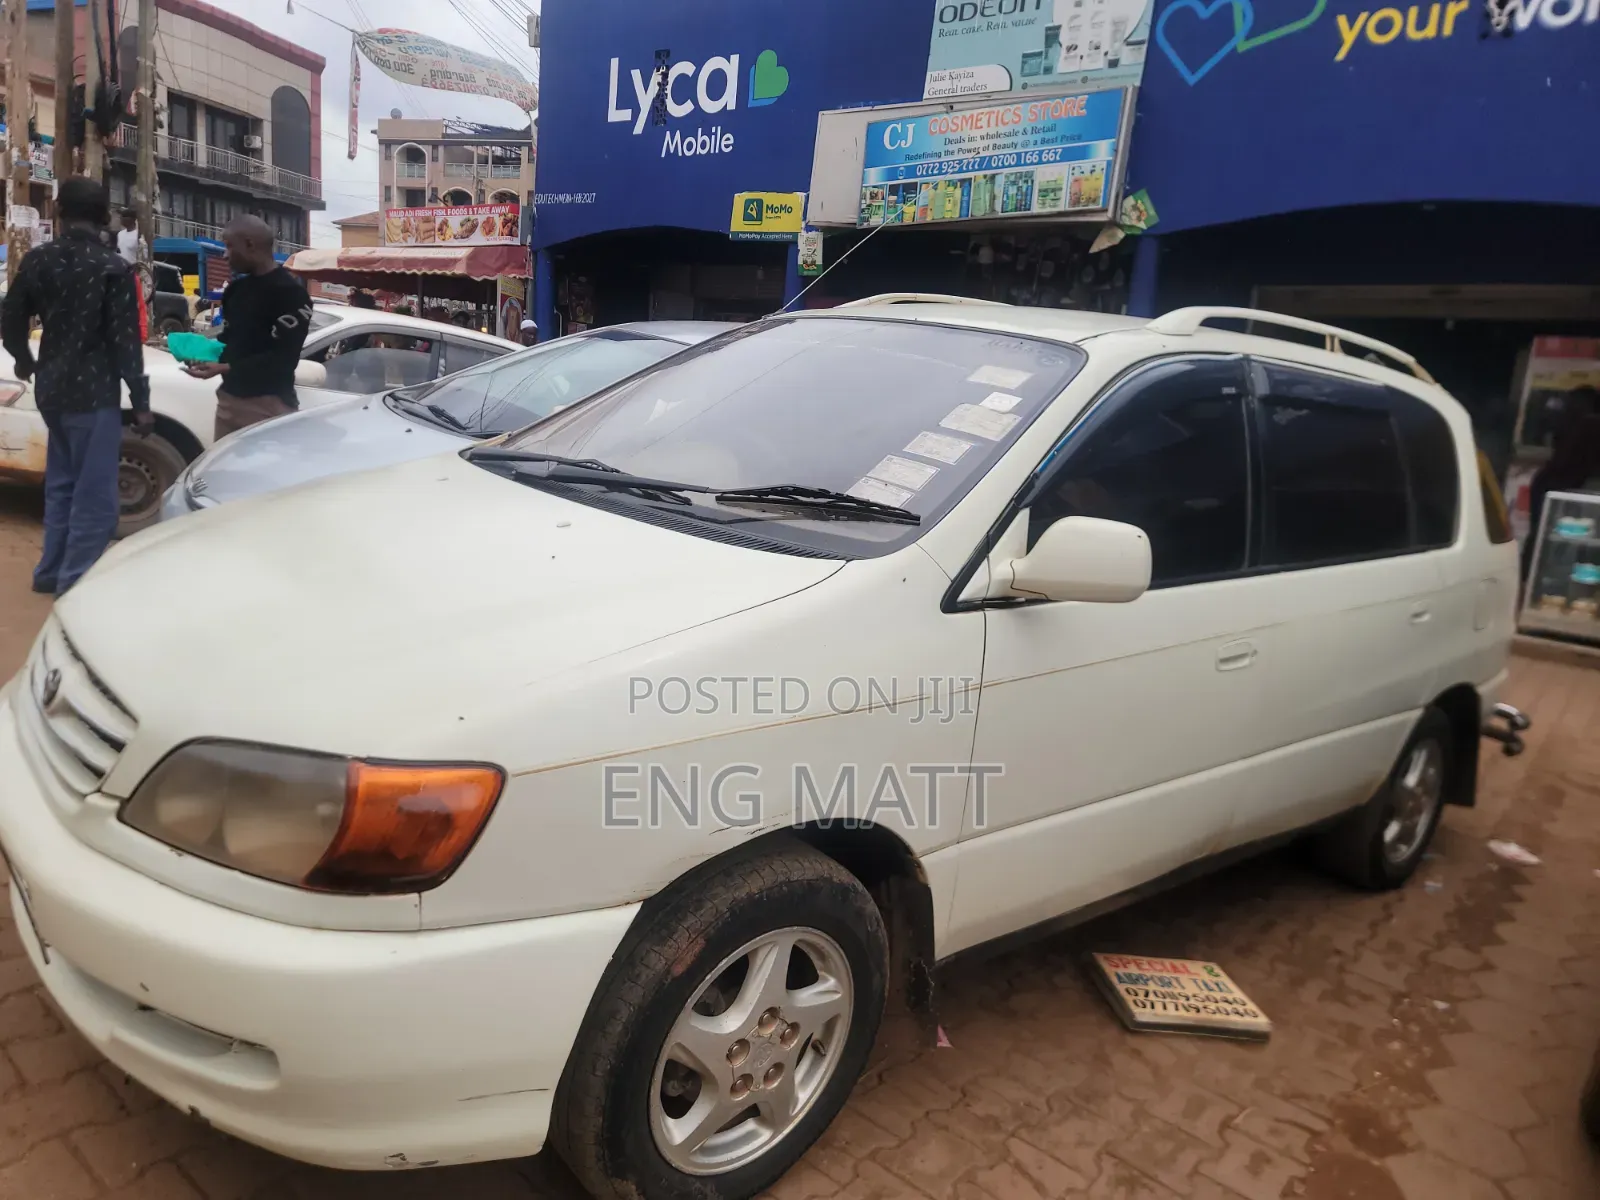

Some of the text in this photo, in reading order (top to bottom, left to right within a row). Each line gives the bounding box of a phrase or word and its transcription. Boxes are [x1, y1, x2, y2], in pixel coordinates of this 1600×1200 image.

[1334, 0, 1470, 61] your
[928, 82, 988, 96] General traders
[929, 71, 974, 84] Julie Kayiza
[607, 54, 740, 135] Lyca
[928, 95, 1088, 136] COSMETICS STORE
[661, 126, 735, 157] Mobile
[883, 122, 916, 150] CJ
[944, 123, 1057, 146] Deals in: wholesale & Retail
[905, 150, 942, 162] Redefining
[943, 149, 956, 157] the
[957, 146, 981, 155] Power
[982, 143, 990, 152] of
[992, 140, 1018, 151] Beauty
[1040, 135, 1059, 145] Best
[916, 162, 940, 176] 0772
[991, 153, 1017, 168] 0700
[1020, 150, 1039, 165] 166
[1041, 148, 1063, 162] 667
[415, 208, 432, 217] FRESH
[447, 206, 468, 216] FOODS
[474, 206, 490, 215] TAKE
[490, 205, 510, 214] AWAY
[765, 204, 793, 214] MoMo
[1102, 956, 1199, 976] SPECIAL
[1114, 971, 1233, 993] AIRPORT TAXI
[1132, 999, 1259, 1018] 0777195040
